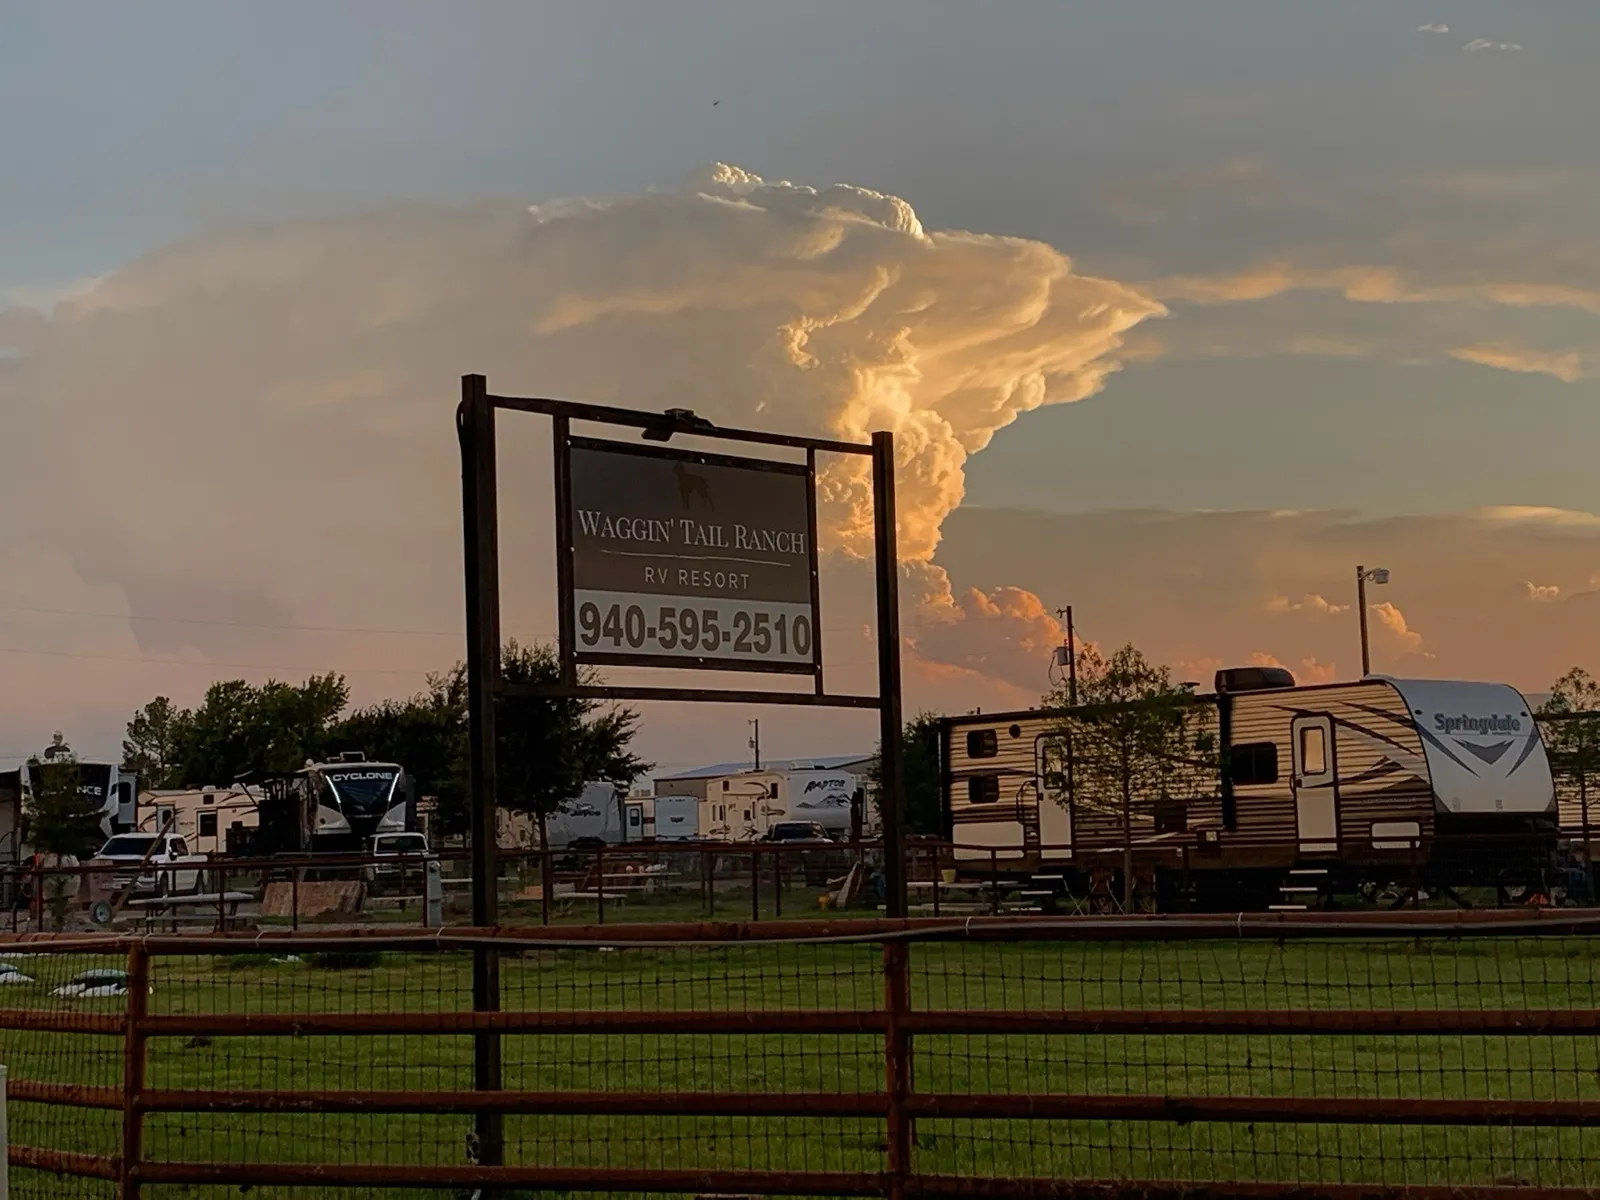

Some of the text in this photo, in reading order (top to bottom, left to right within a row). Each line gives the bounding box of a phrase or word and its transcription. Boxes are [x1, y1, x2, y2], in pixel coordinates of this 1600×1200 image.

[680, 519, 729, 548] TAIL
[734, 524, 806, 554] RANCH
[645, 566, 750, 589] RV RESORT
[579, 601, 811, 656] 940-595-2510
[1434, 713, 1521, 735] Springdale
[332, 772, 393, 782] CYCLONE
